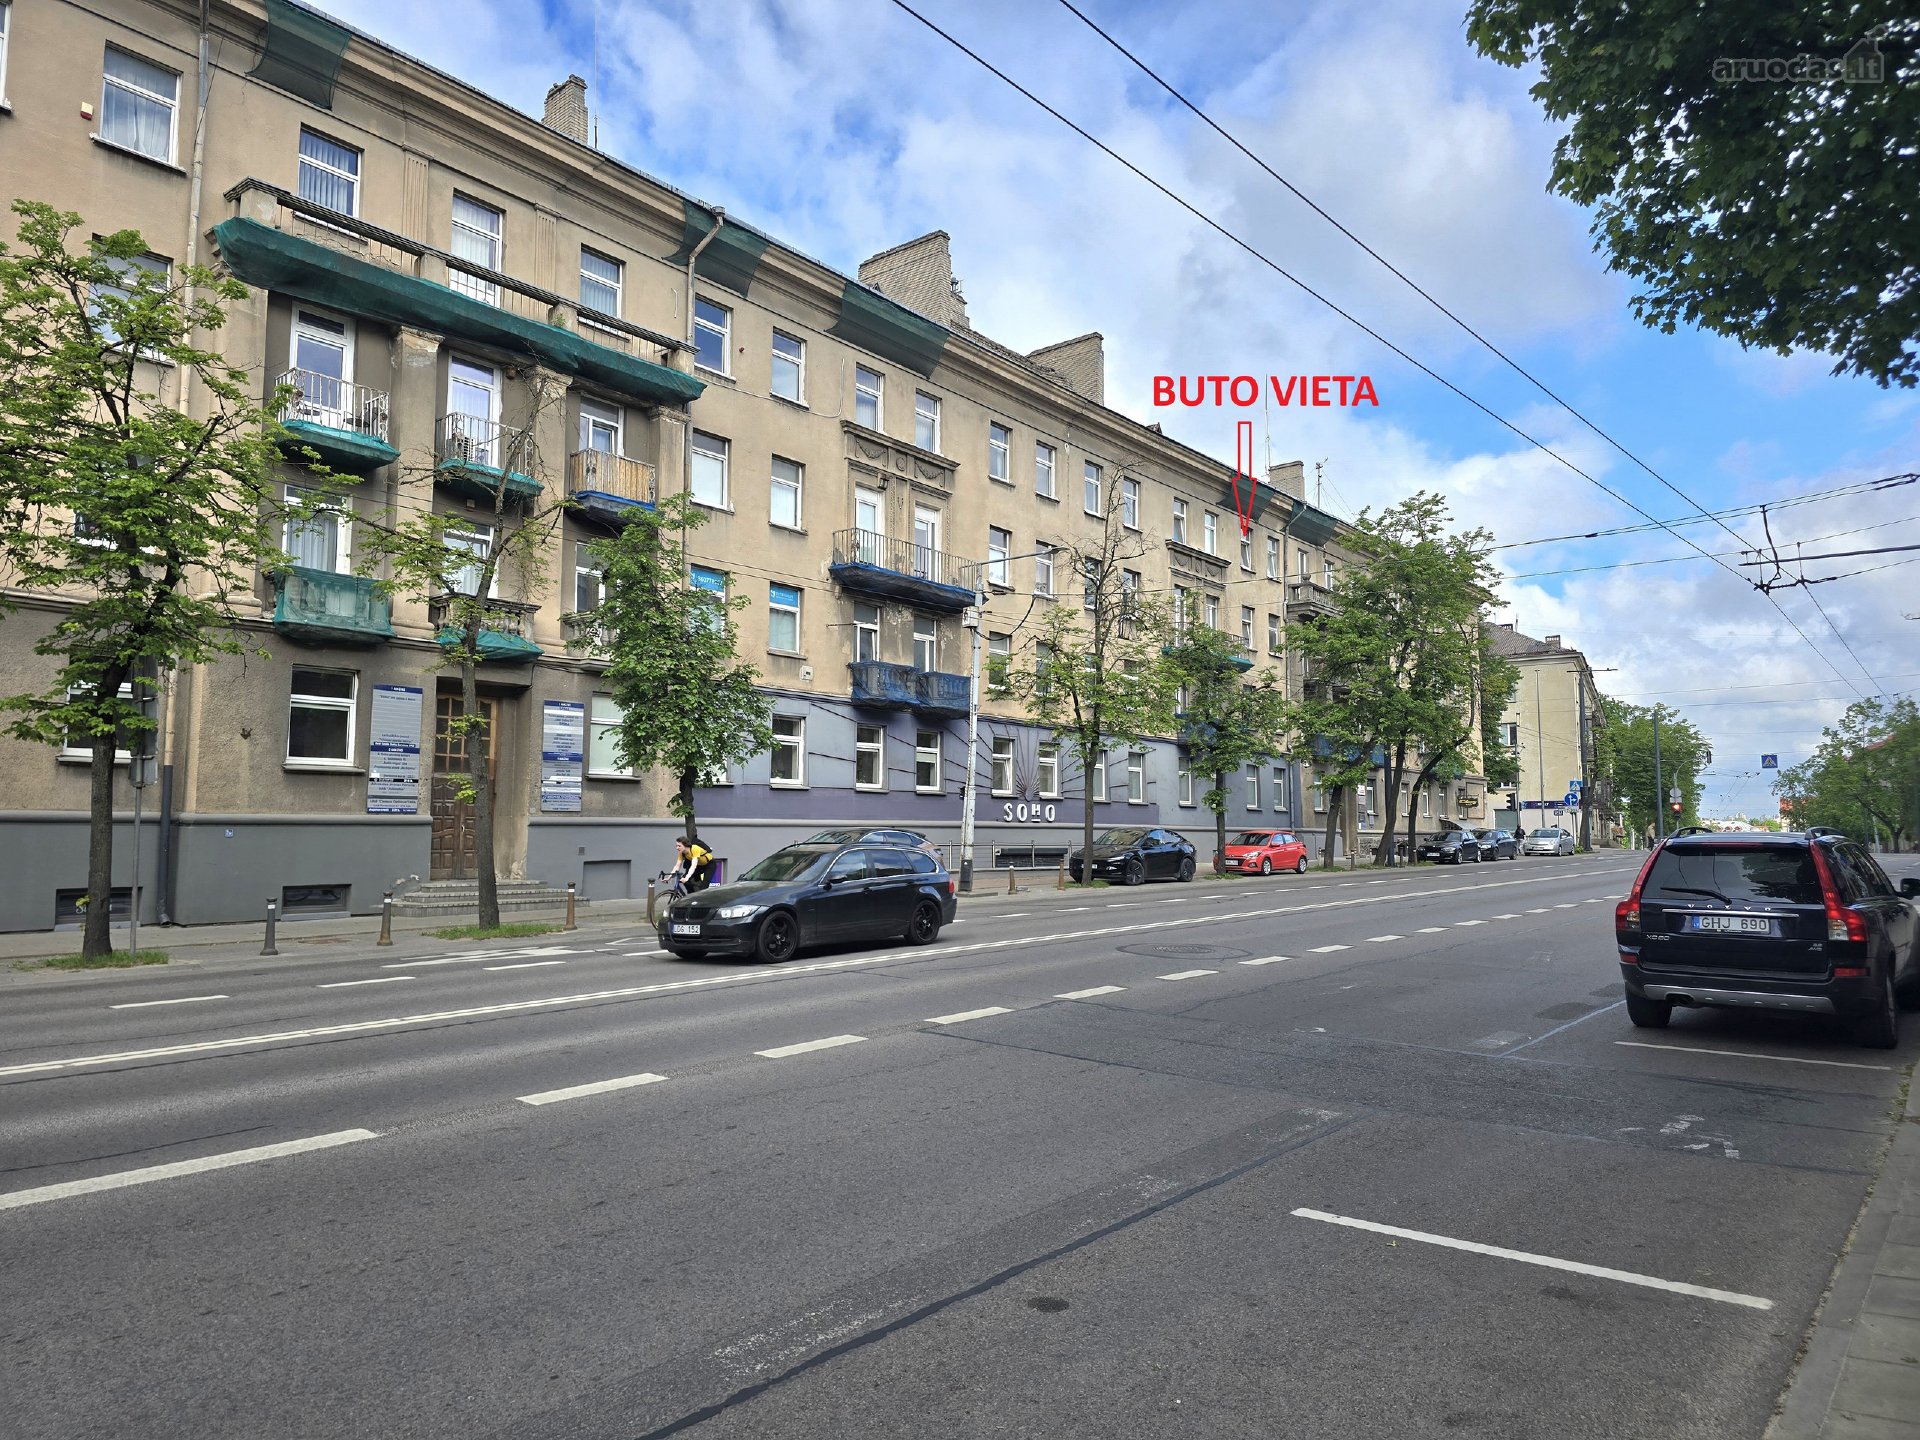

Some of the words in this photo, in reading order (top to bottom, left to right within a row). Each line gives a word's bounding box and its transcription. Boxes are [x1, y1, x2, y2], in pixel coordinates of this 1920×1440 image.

[1003, 802, 1056, 822] SOHO
[688, 925, 699, 934] 152
[1701, 917, 1731, 929] GHJ
[1740, 919, 1767, 931] 690
